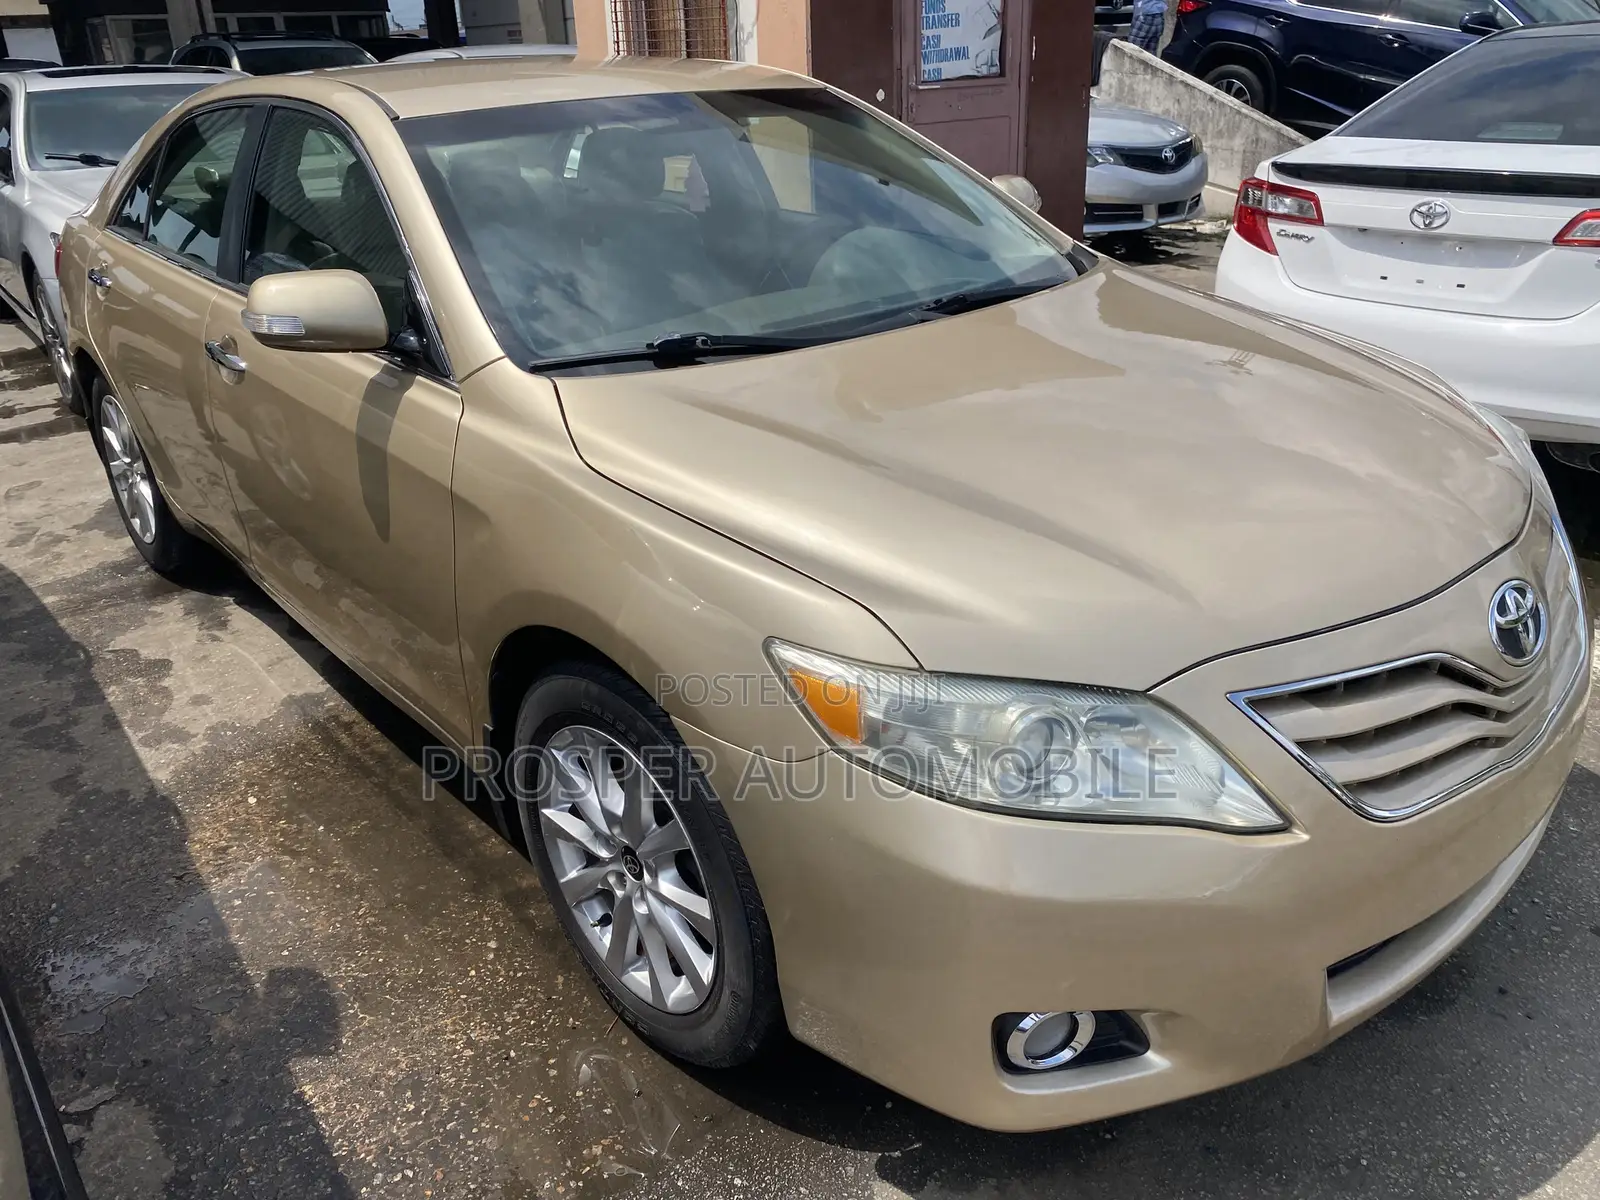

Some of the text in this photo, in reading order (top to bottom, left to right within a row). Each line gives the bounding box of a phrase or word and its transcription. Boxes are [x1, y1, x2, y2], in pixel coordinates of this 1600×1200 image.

[921, 0, 946, 15] FUNDS
[921, 13, 960, 30] TRANSFER
[921, 34, 941, 50] CASH
[921, 46, 970, 65] WITHDRAWAL
[922, 68, 942, 80] CASH
